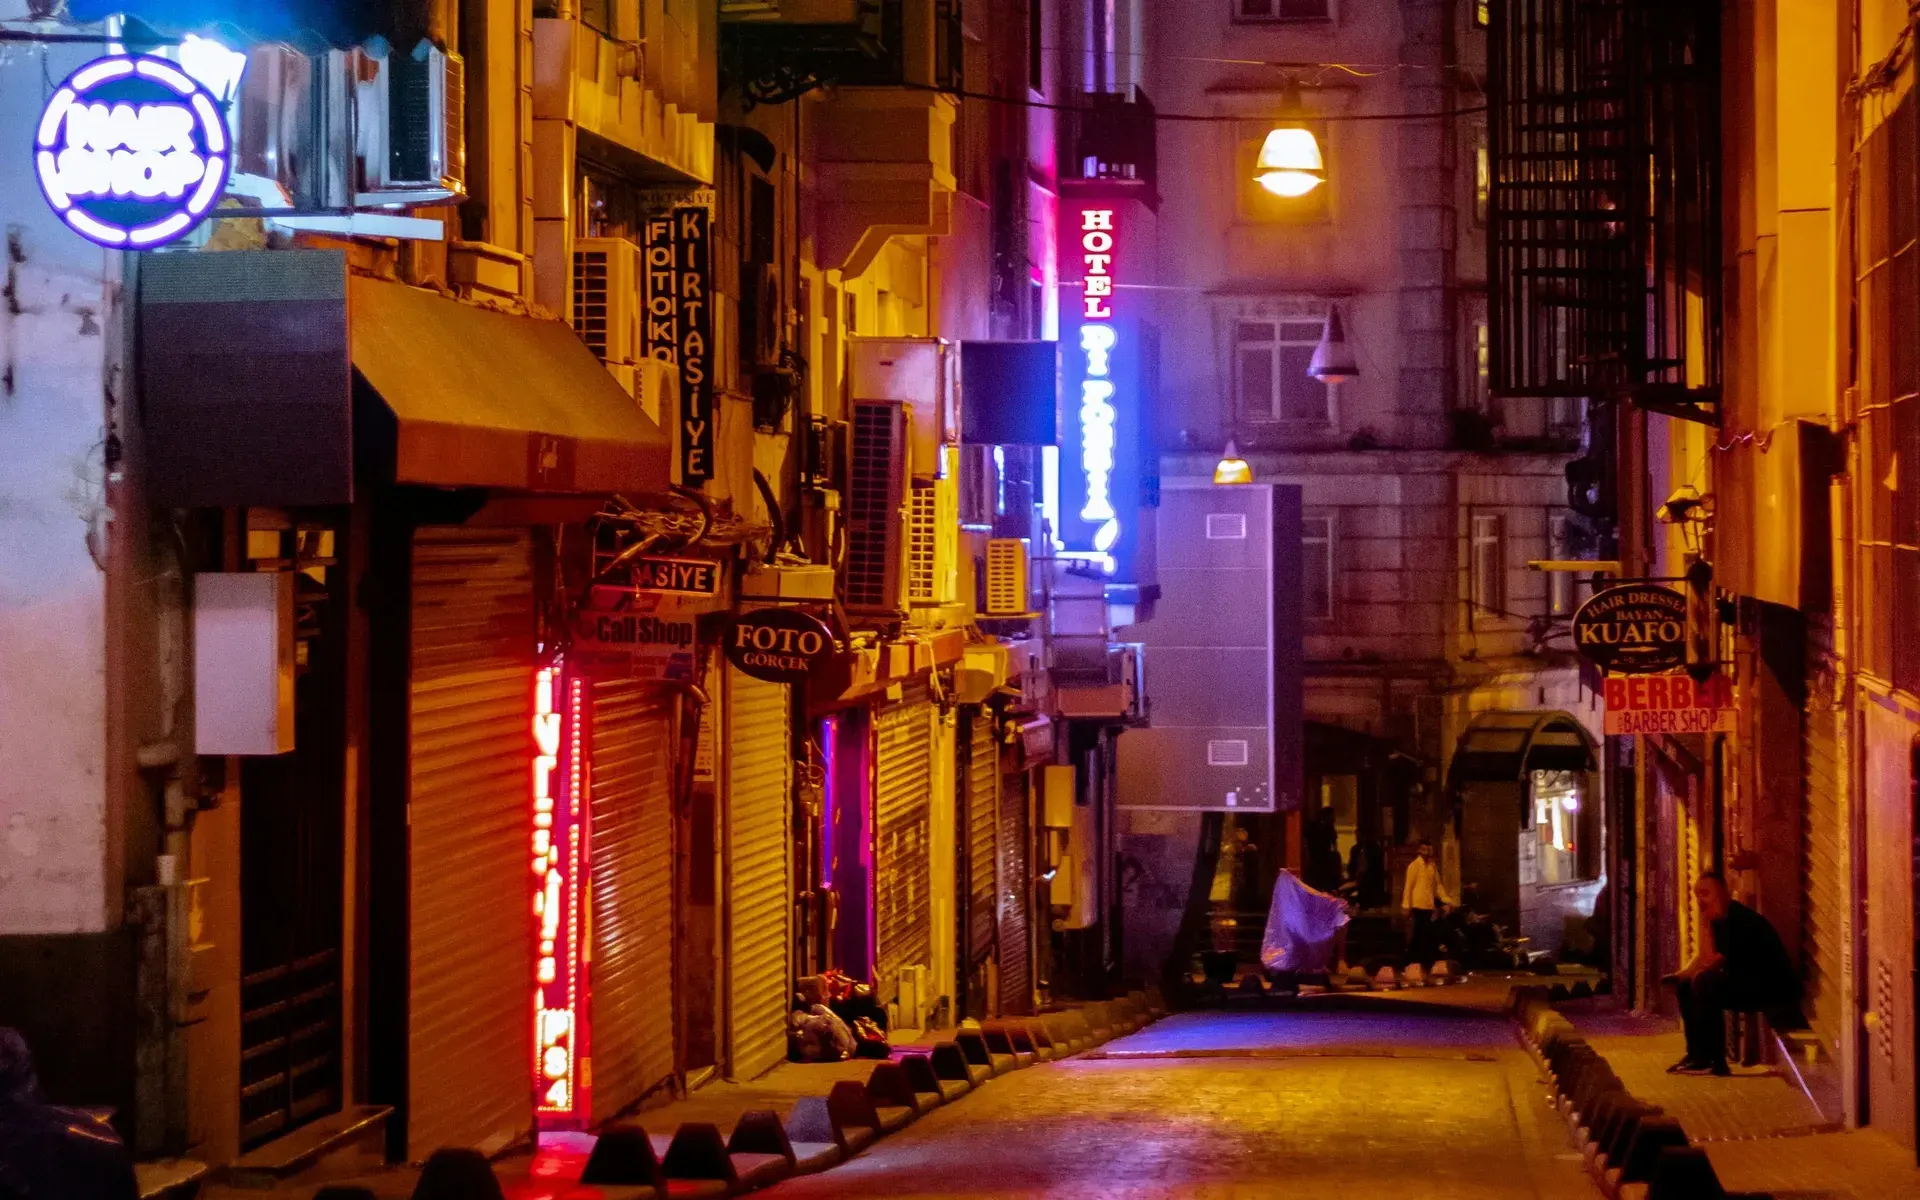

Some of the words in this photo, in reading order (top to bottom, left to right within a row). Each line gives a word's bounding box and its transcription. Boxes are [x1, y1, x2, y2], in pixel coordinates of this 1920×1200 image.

[1081, 210, 1113, 318] HOTEL
[681, 212, 706, 476] KIRTASİYE
[1587, 595, 1626, 618] HAIR
[1616, 610, 1663, 620] BAYAN
[597, 615, 637, 643] Call
[638, 617, 693, 649] Shop
[736, 624, 823, 655] FOTO
[1623, 711, 1677, 733] BARBER
[1680, 709, 1719, 732] SHOP
